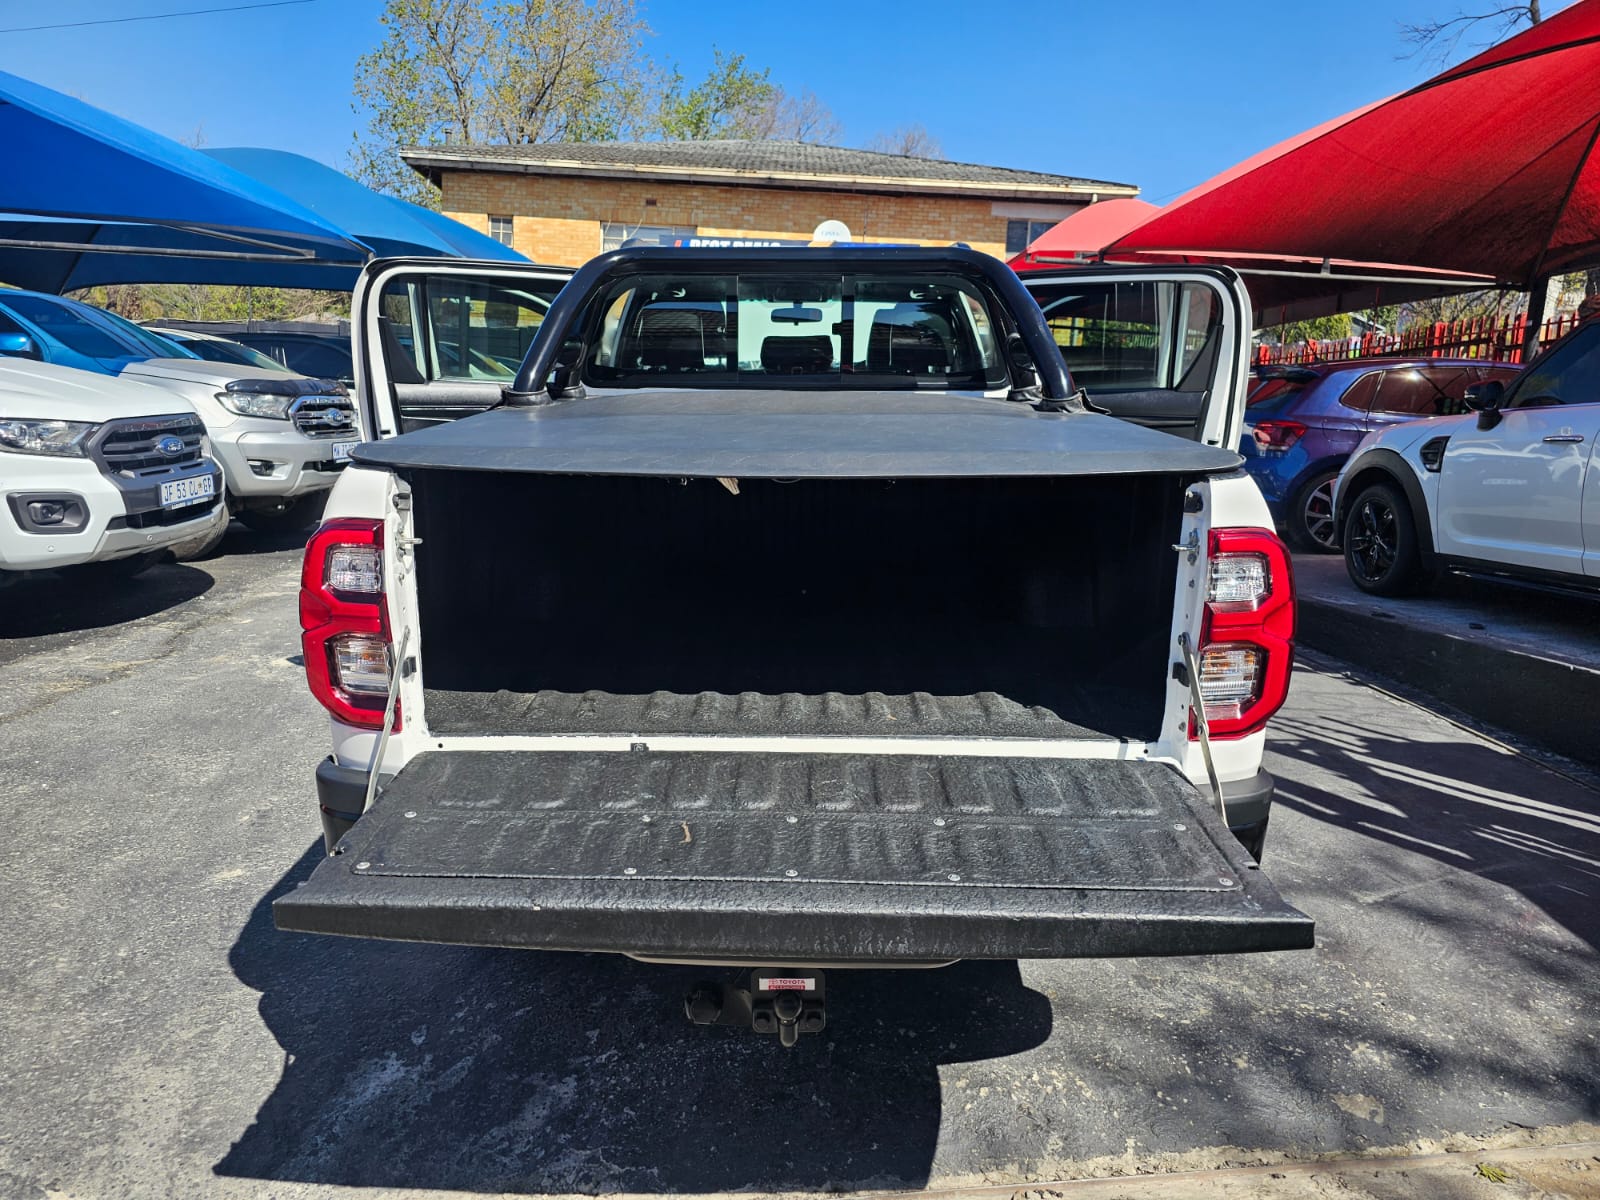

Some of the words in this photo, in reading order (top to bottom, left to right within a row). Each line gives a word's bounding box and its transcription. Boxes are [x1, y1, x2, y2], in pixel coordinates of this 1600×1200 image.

[164, 484, 173, 502] JF
[176, 482, 187, 499] 53
[202, 477, 212, 493] GP
